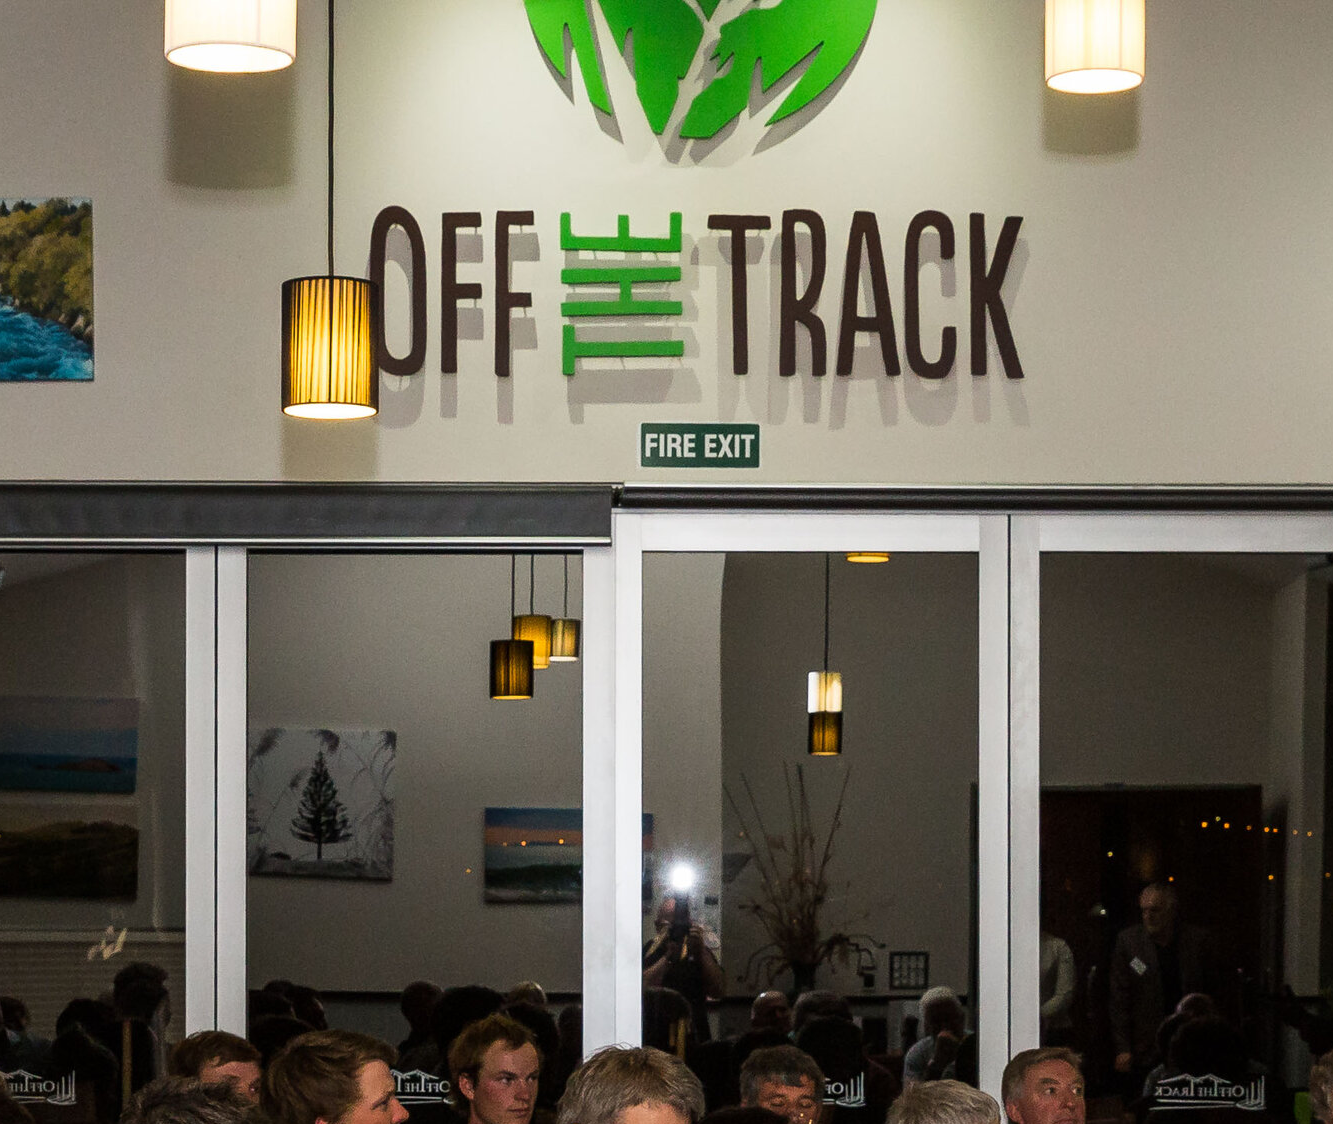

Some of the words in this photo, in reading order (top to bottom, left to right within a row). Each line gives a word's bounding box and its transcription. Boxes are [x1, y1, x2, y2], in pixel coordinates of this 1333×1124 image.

[369, 205, 535, 378] OFF
[560, 212, 684, 376] THE
[707, 208, 1025, 379] TRACK
[645, 433, 696, 458] FIRE
[704, 433, 755, 459] EXIT
